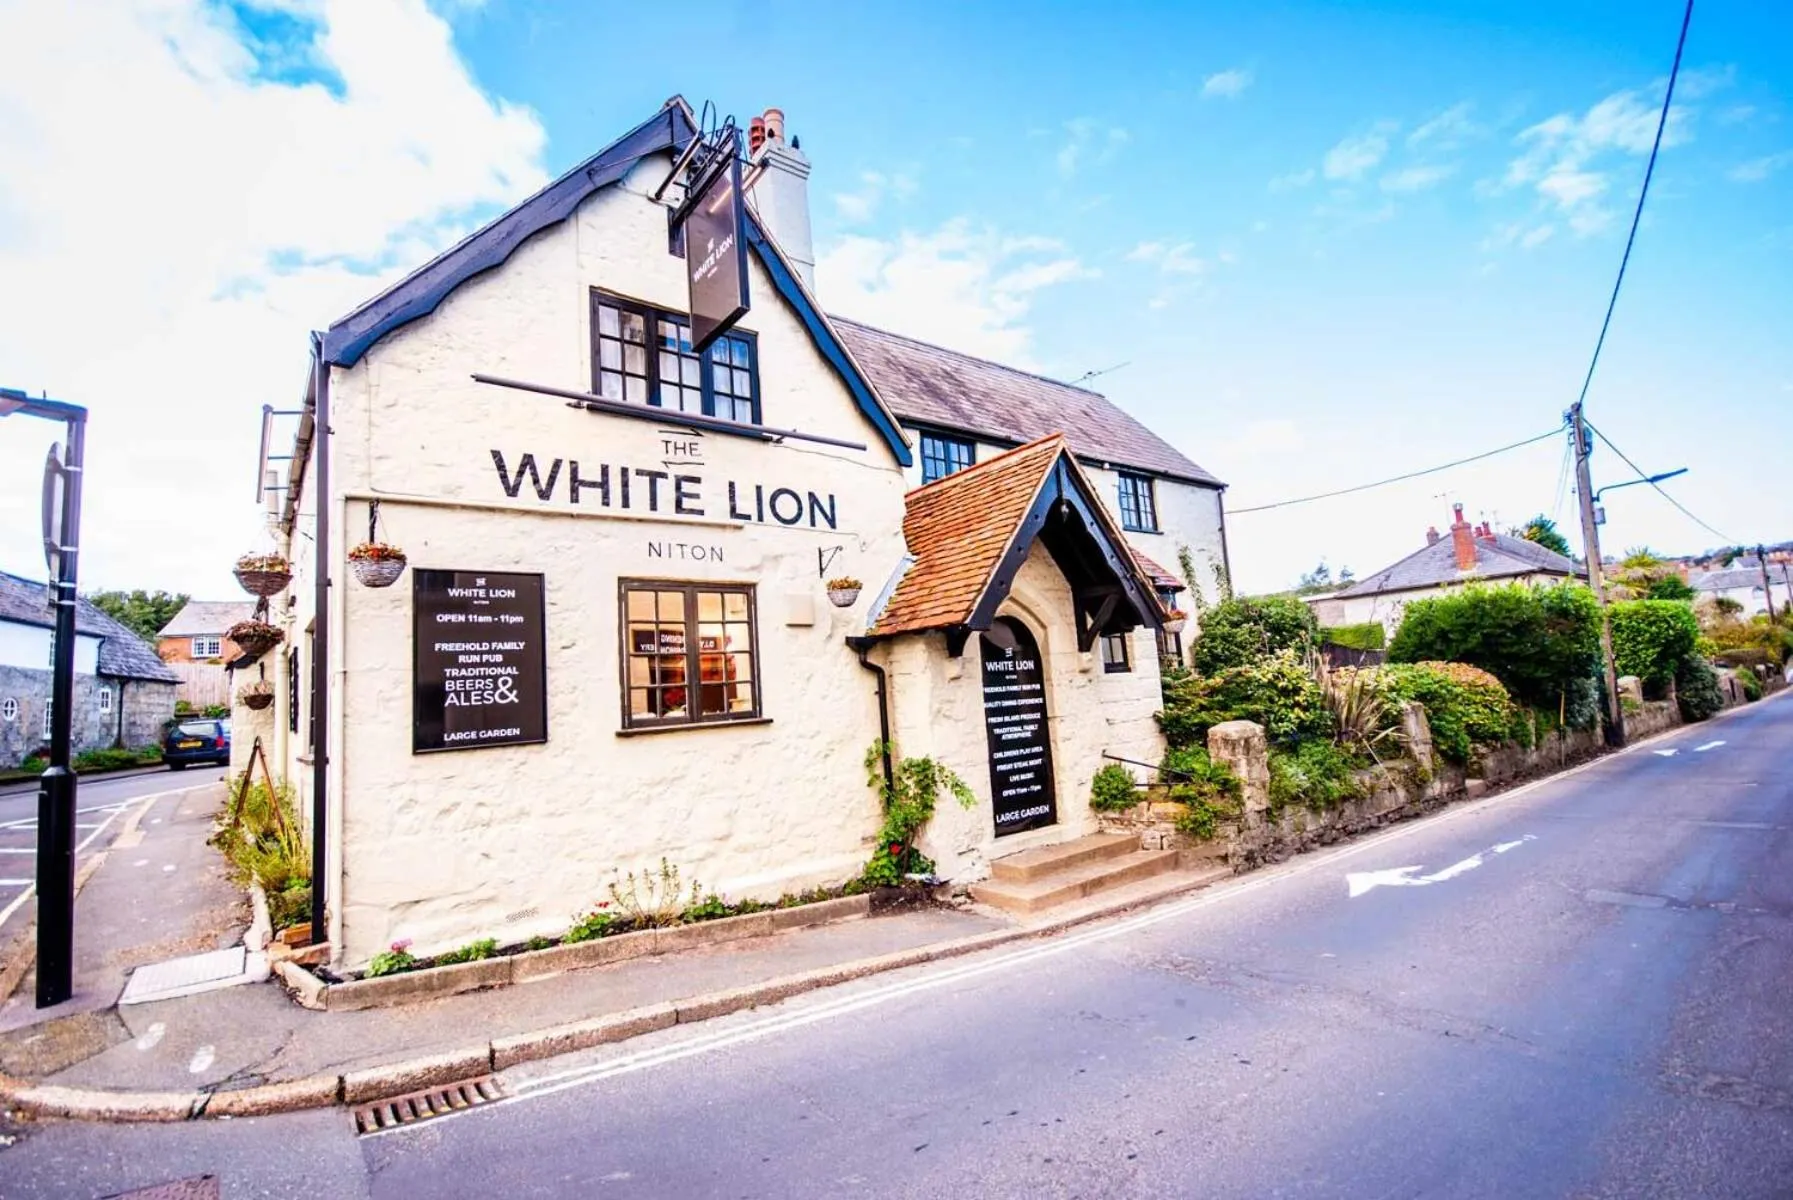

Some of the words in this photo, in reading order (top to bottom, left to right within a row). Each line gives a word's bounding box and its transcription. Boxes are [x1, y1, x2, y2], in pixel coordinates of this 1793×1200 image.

[693, 252, 715, 282] WHITE
[715, 233, 733, 259] LION
[661, 440, 702, 457] THE
[490, 449, 704, 516] WHITE
[728, 480, 837, 530] LION
[648, 541, 723, 562] NITON
[447, 588, 487, 598] WHITE
[489, 589, 516, 598] LION
[436, 614, 466, 623] OPEN
[467, 614, 493, 623] 11am
[499, 615, 524, 625] 11pm
[434, 642, 490, 652] FREEHOLD
[491, 641, 526, 650] FAMILY
[458, 655, 481, 663] RUN
[482, 654, 504, 662] PUB
[985, 661, 1014, 671] WHITE
[1015, 660, 1034, 670] LION
[444, 666, 520, 677] TRADITIONAL
[445, 678, 494, 692] BEERS
[494, 676, 519, 704] &
[444, 690, 494, 708] ALES
[443, 731, 478, 742] LARGE
[479, 728, 521, 738] GARDEN
[996, 810, 1020, 823] LARGE
[1020, 805, 1050, 818] GARDEN
